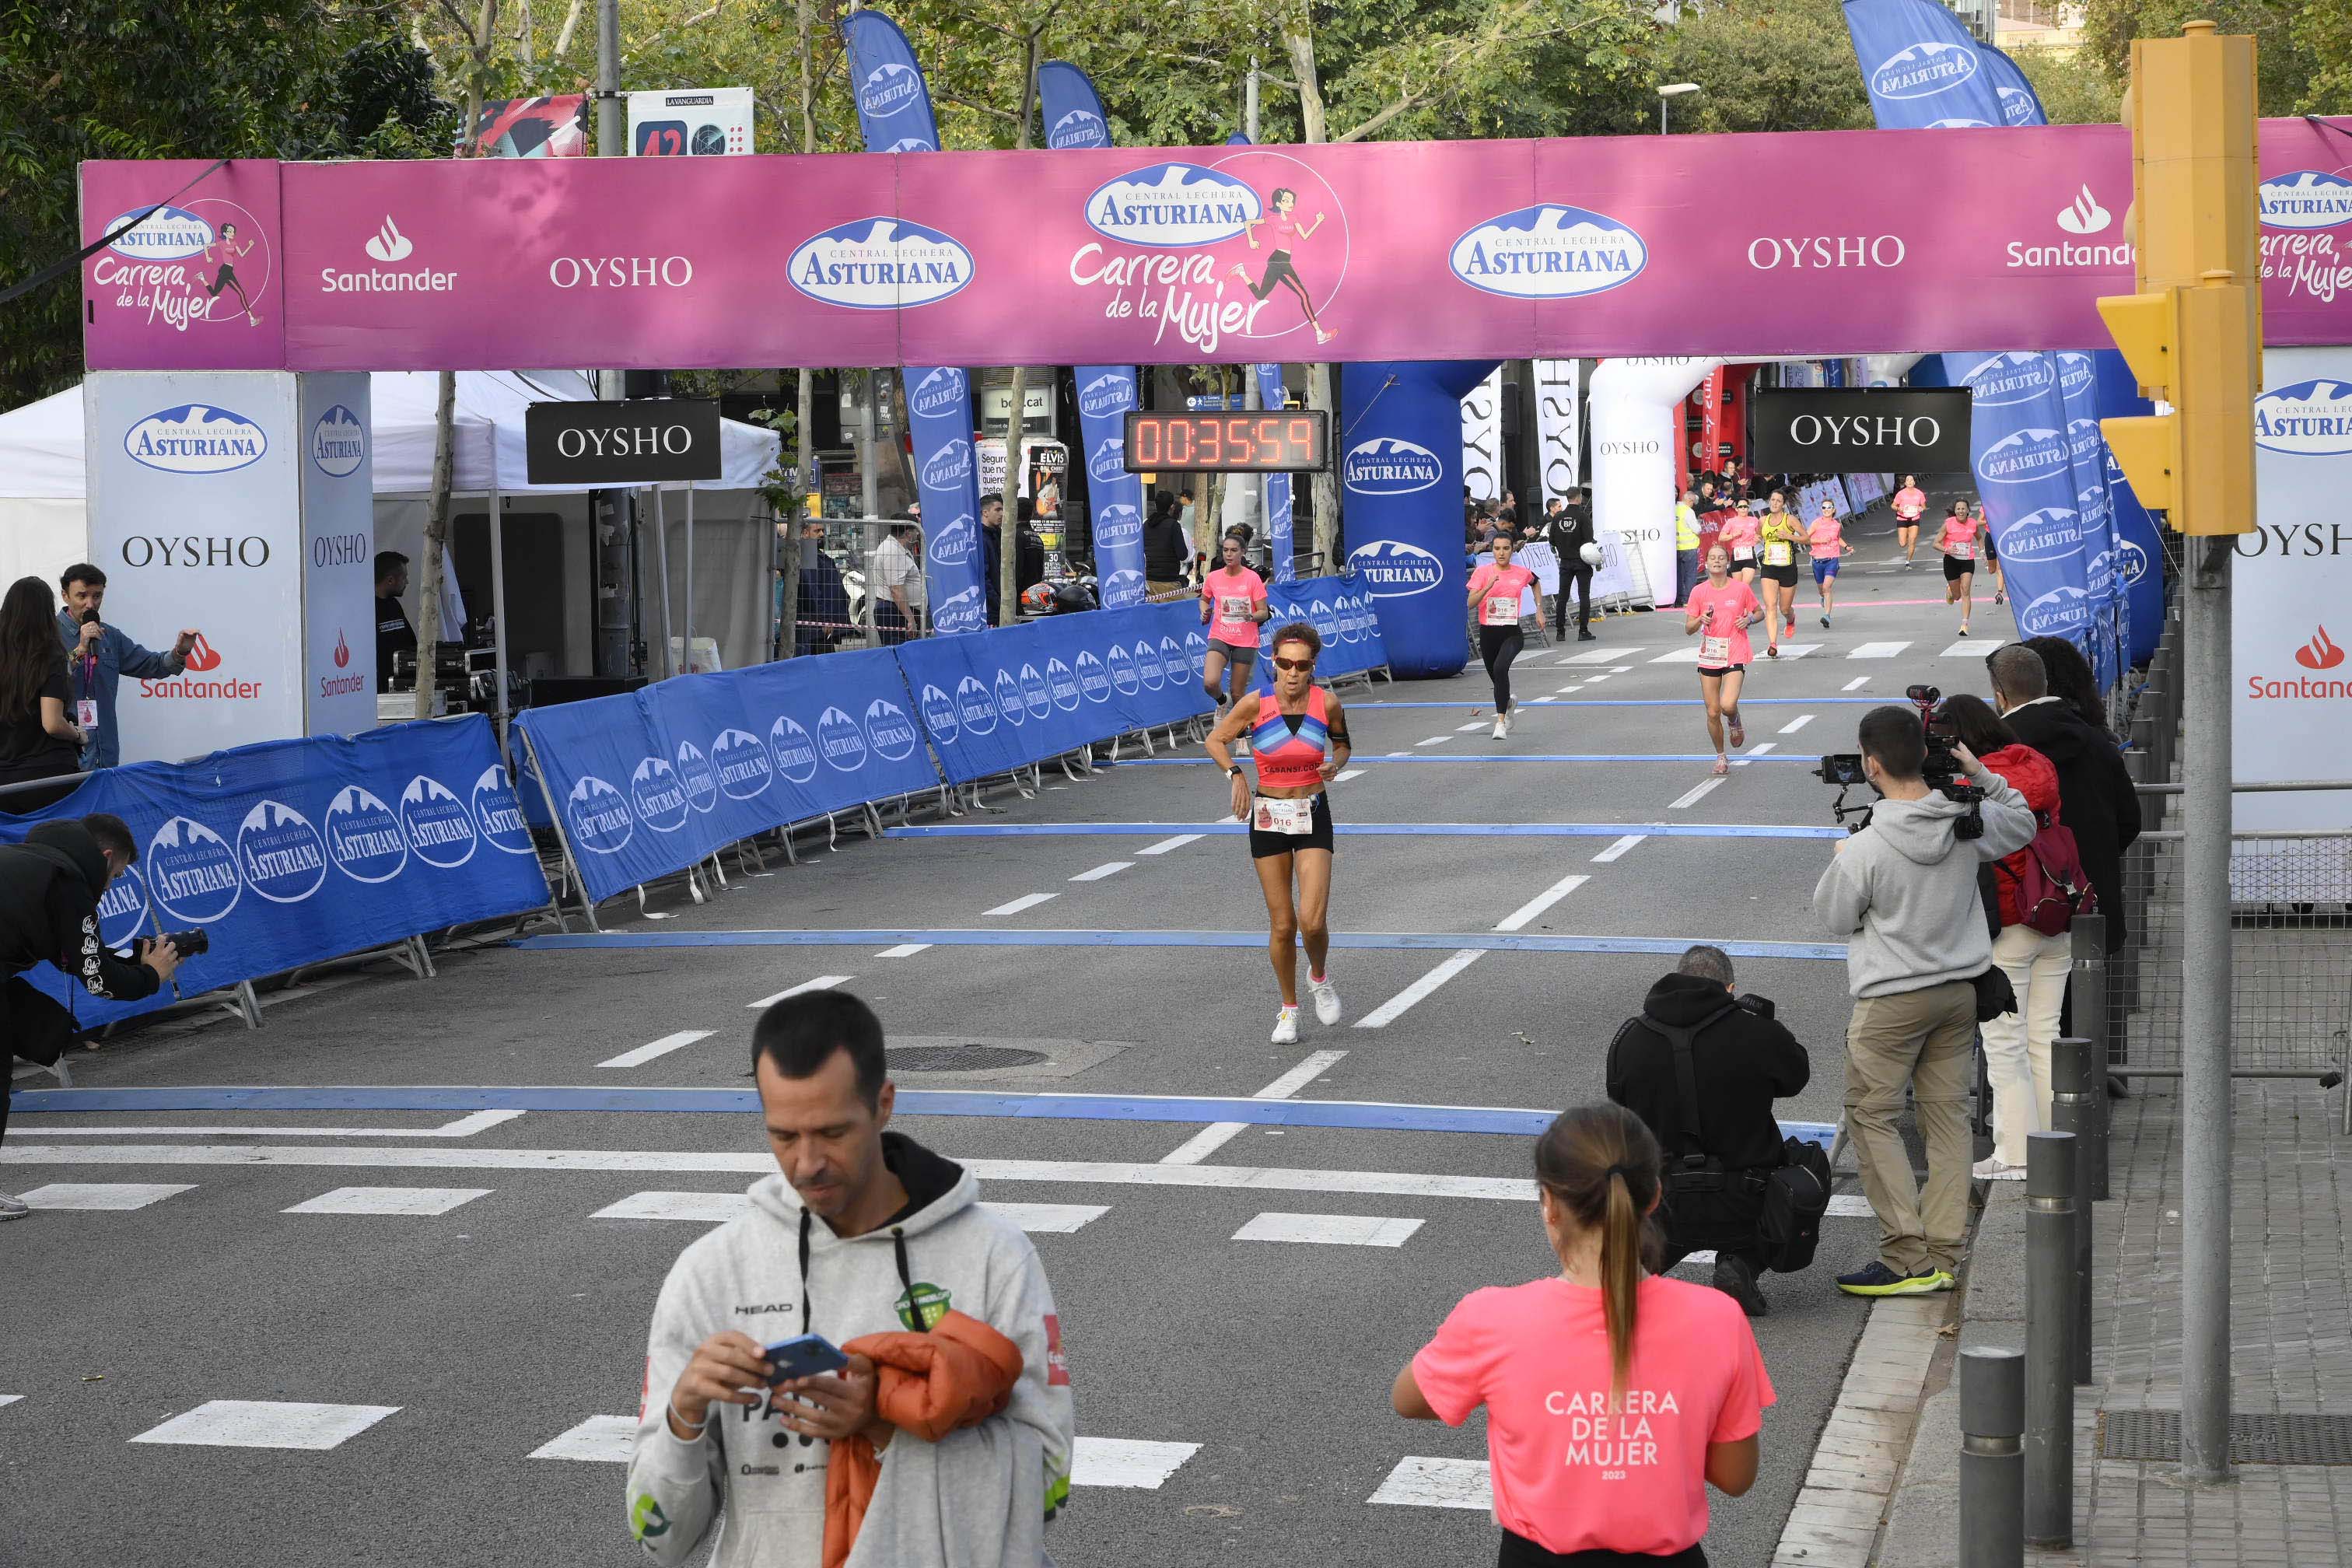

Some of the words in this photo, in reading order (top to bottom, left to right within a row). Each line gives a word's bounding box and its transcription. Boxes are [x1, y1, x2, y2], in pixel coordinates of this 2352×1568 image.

[674, 96, 712, 105] VANGUARDIA
[1098, 195, 1248, 226] ASTURIANA
[112, 225, 205, 246] ASTURIANA
[1495, 238, 1556, 247] CENTRAL
[1563, 236, 1625, 245] LECHERA
[2260, 234, 2334, 255] arrera
[830, 250, 888, 258] CENTRAL
[894, 249, 954, 257] LECHERA
[1069, 243, 1216, 285] Carrera
[1465, 241, 1632, 275] ASTURIANA
[1748, 236, 1905, 269] OYSHO
[93, 257, 185, 285] Carrera
[321, 267, 457, 292] Santander
[549, 257, 692, 288] OYSHO
[801, 251, 960, 285] ASTURIANA
[2278, 257, 2292, 278] la
[117, 287, 133, 306] de
[138, 288, 149, 306] la
[148, 284, 220, 331] Mujer
[1105, 289, 1132, 318] de
[1139, 286, 1158, 318] la
[1153, 281, 1270, 354] Mujer
[1001, 397, 1043, 408] bc.cat
[135, 430, 257, 456] ASTURIANA
[558, 426, 691, 459] OYSHO
[1138, 420, 1311, 462] 00:35:59
[1790, 415, 1941, 446] OYSHO
[316, 432, 362, 459] ASTURIANA
[1040, 453, 1064, 463] ELVIS
[1600, 440, 1659, 456] OYSHO
[982, 467, 995, 475] que
[982, 475, 1005, 484] quiere
[1347, 461, 1435, 482] ASTURIANA
[1624, 528, 1661, 541] SHO
[122, 536, 270, 567] OYSHO
[314, 533, 366, 567] OYSHO
[1520, 544, 1551, 570] OYSH
[1346, 562, 1435, 583] TURIANA
[141, 677, 261, 698] Santander
[320, 672, 364, 698] Santander
[927, 709, 957, 731] ATURIANA
[822, 733, 864, 758] ASTURIANA
[870, 724, 912, 747] ASTURNA
[775, 743, 814, 768] ASTURIANA
[716, 757, 770, 786] ASTURIANA
[341, 821, 367, 831] CENTRAL
[408, 814, 473, 848] ASTURIANA
[576, 807, 630, 840] ASTRIANA
[253, 838, 281, 849] CENTRAL
[282, 830, 311, 842] LECHERA
[333, 826, 404, 862] ASTURIANA
[165, 853, 196, 866] CENTRAL
[196, 848, 225, 862] LECHERA
[246, 843, 323, 882] ASTURIANA
[156, 861, 237, 902] ASTURIANA
[735, 1304, 793, 1315] HEAD
[1572, 1417, 1608, 1440] DE
[1620, 1416, 1654, 1440] LA
[1565, 1442, 1658, 1466] MUJER
[1601, 1471, 1626, 1480] 2023
